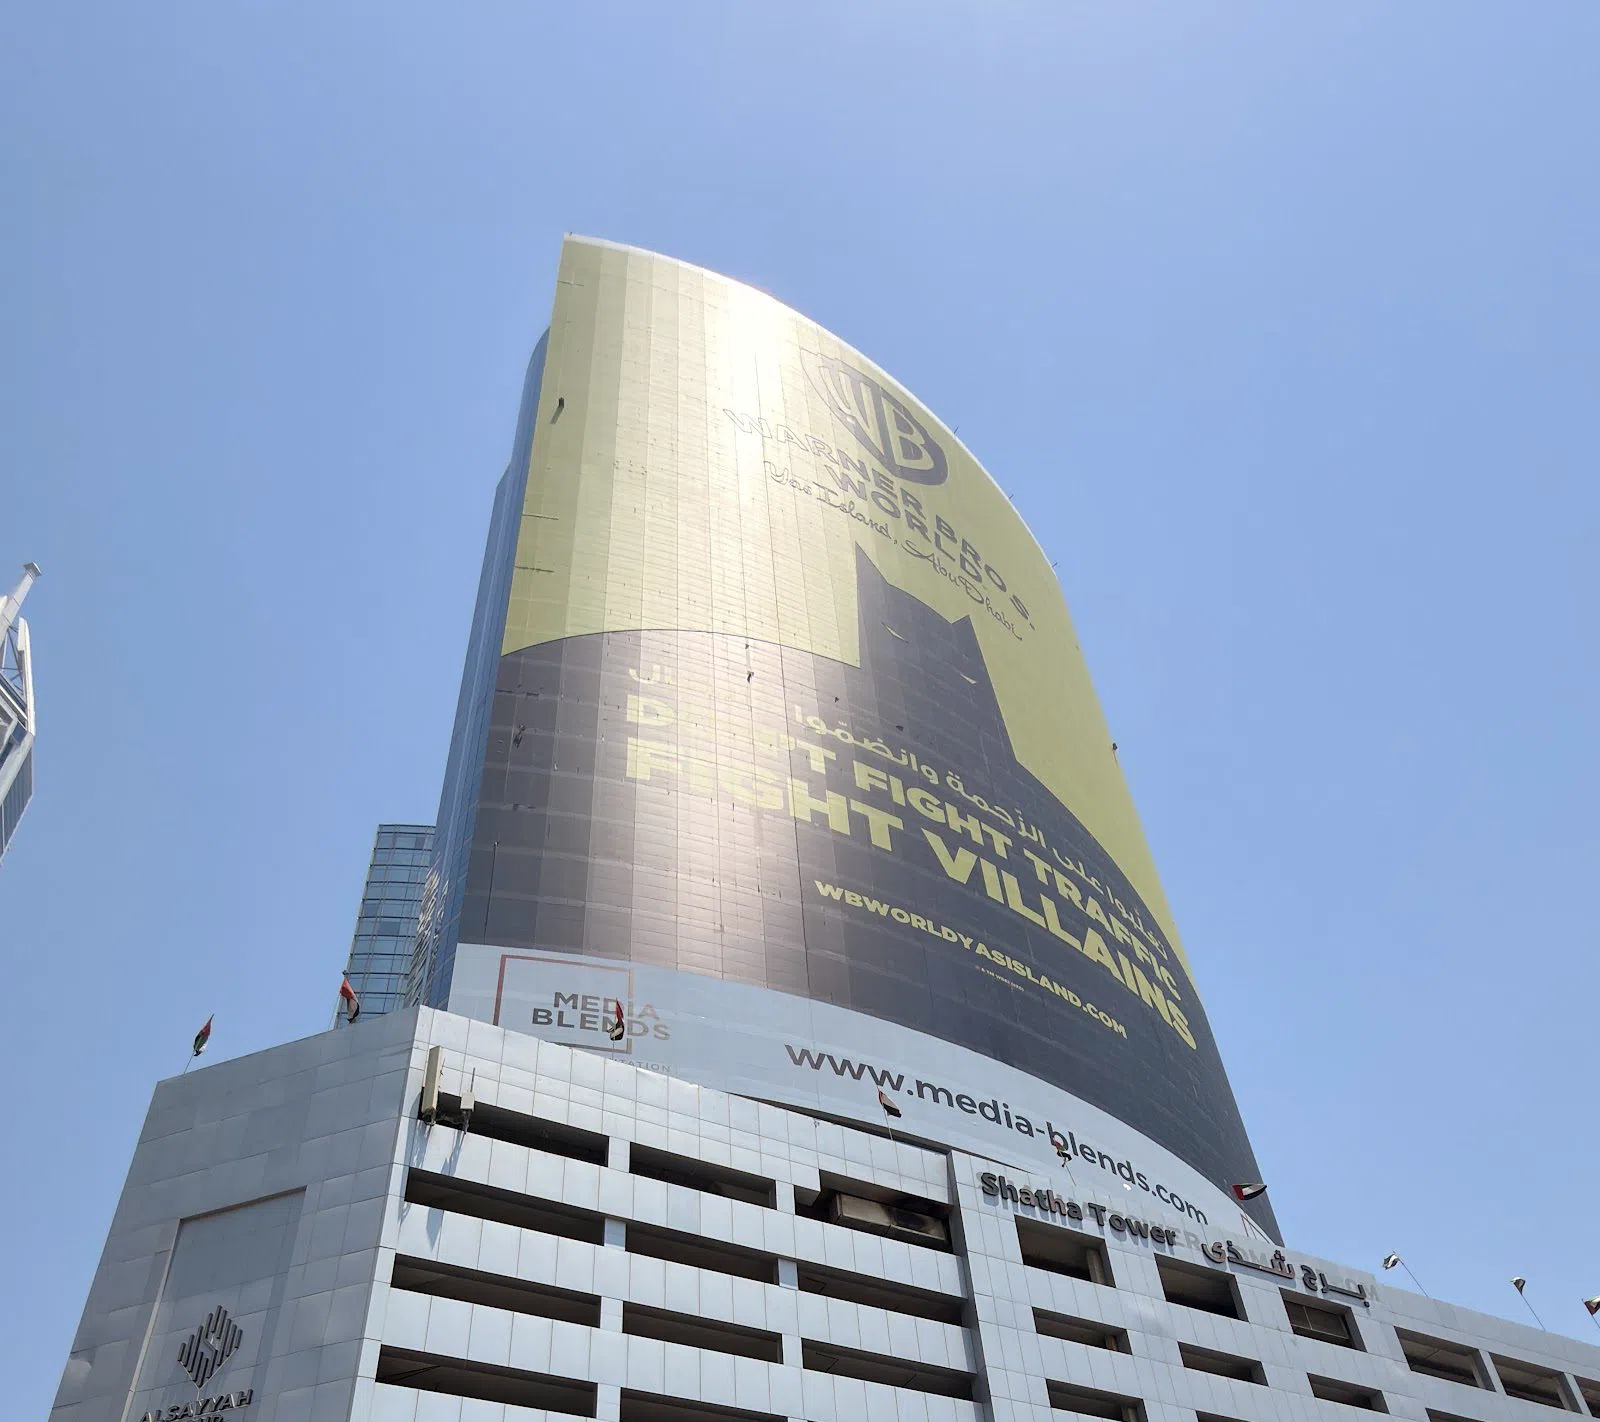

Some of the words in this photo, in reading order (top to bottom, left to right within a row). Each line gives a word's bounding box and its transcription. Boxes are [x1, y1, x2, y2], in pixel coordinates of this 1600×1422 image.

[722, 408, 927, 520] WARNER
[824, 464, 984, 583] WORLD
[626, 736, 904, 852] FIGHT
[921, 827, 1197, 1050] VILLAINS
[853, 759, 1013, 860] FIGHT
[1023, 847, 1182, 1001] TRAFFIC
[553, 991, 661, 1021] MEDIA
[814, 879, 1128, 1040] WBWORLDYASISLAND.COM
[532, 1007, 671, 1041] BLENDS
[784, 1043, 1208, 1226] www.media-blends.com
[980, 1171, 1083, 1221] Shatha
[1087, 1201, 1177, 1248] Tower
